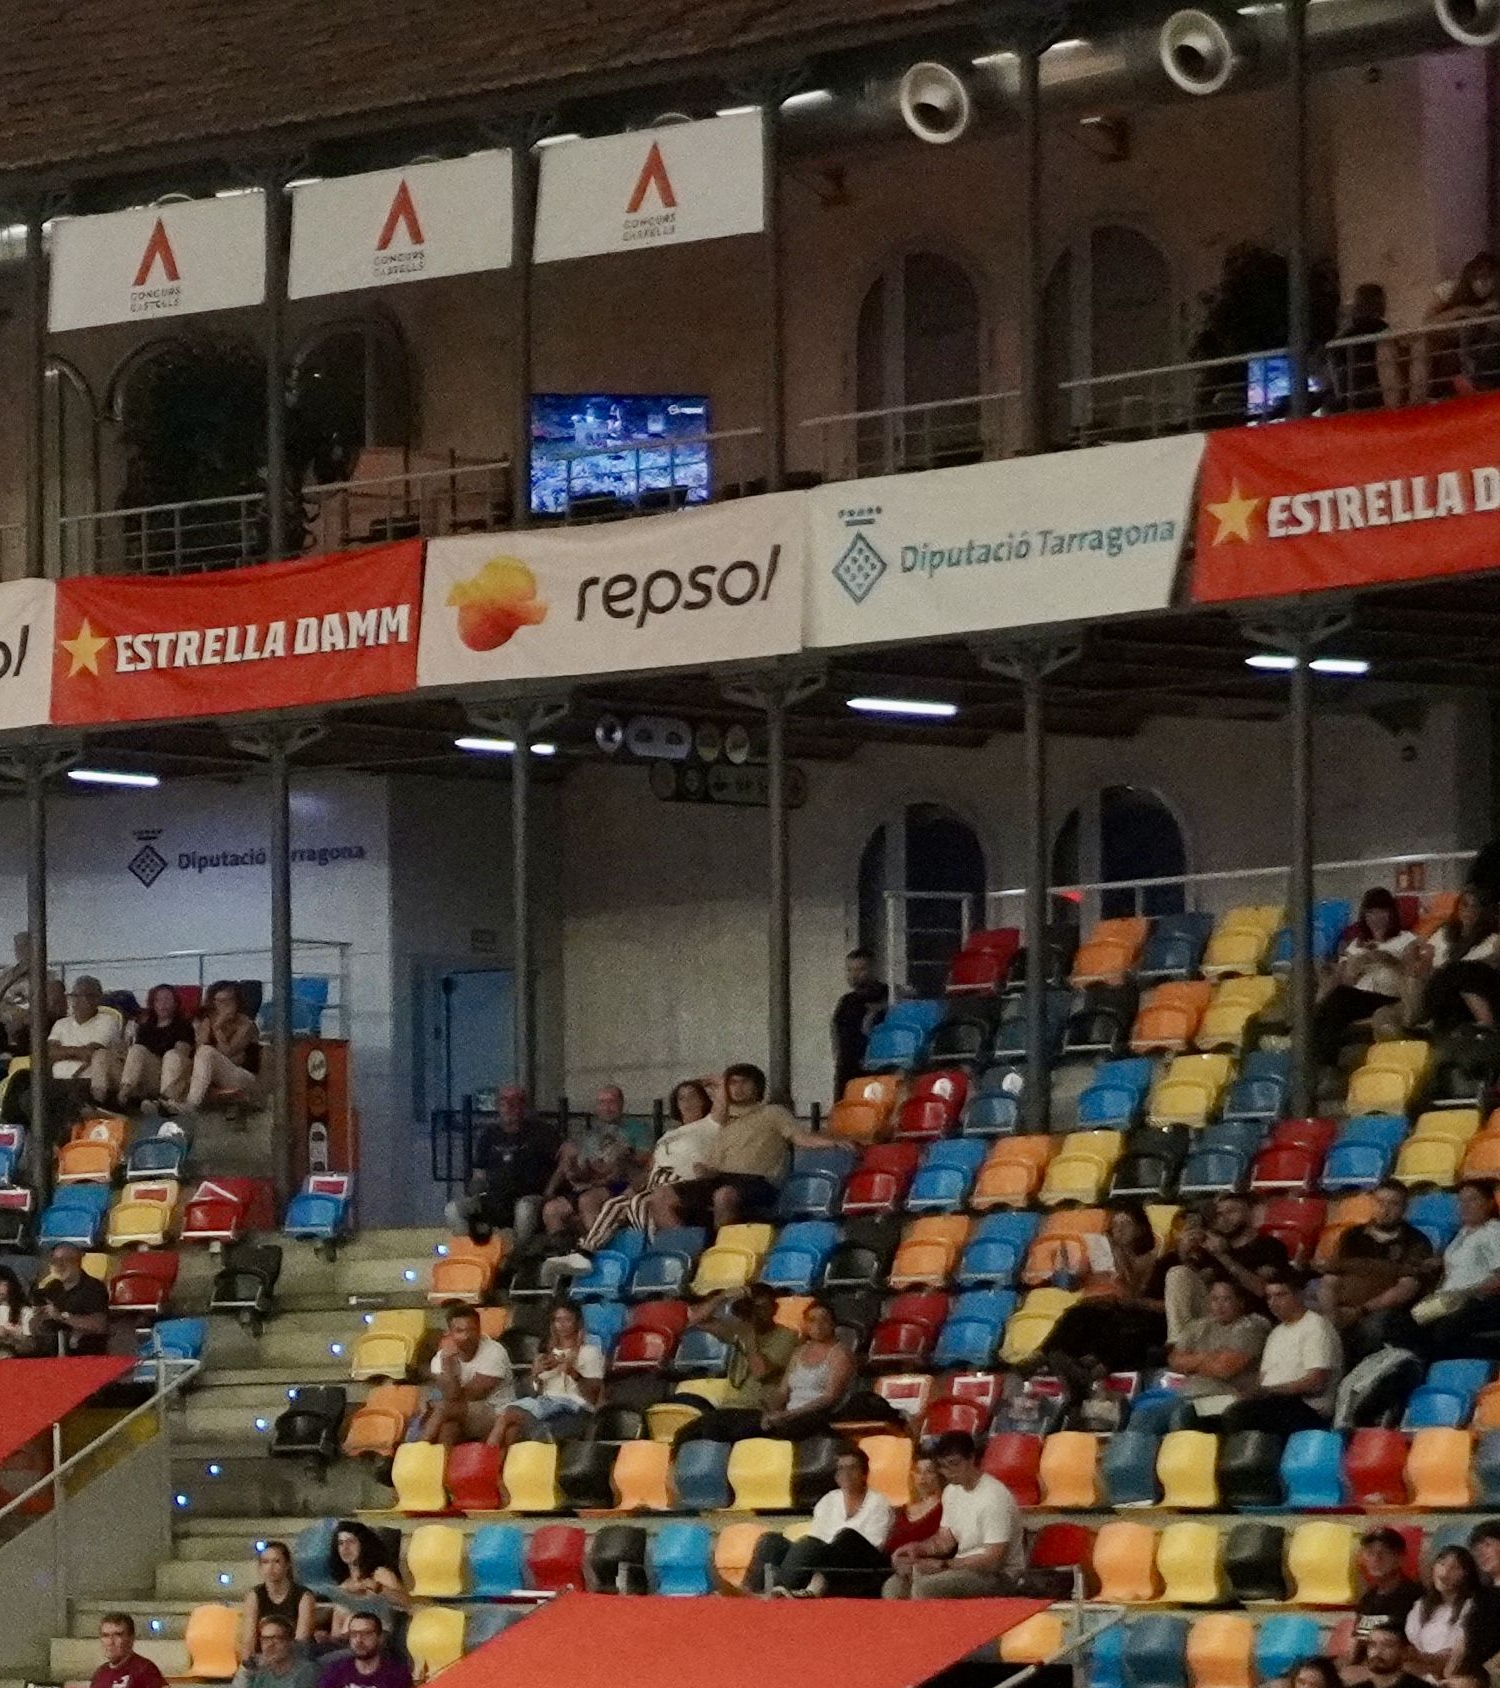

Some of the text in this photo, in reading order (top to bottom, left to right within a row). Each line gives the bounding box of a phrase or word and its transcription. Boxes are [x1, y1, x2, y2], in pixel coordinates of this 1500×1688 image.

[1267, 470, 1462, 539] ESTRELLA
[900, 518, 1176, 577] Diputació Tarragona
[576, 544, 781, 629] repsol
[114, 604, 410, 674] ESTRELLA DAMM
[178, 845, 364, 872] Diputació rragona
